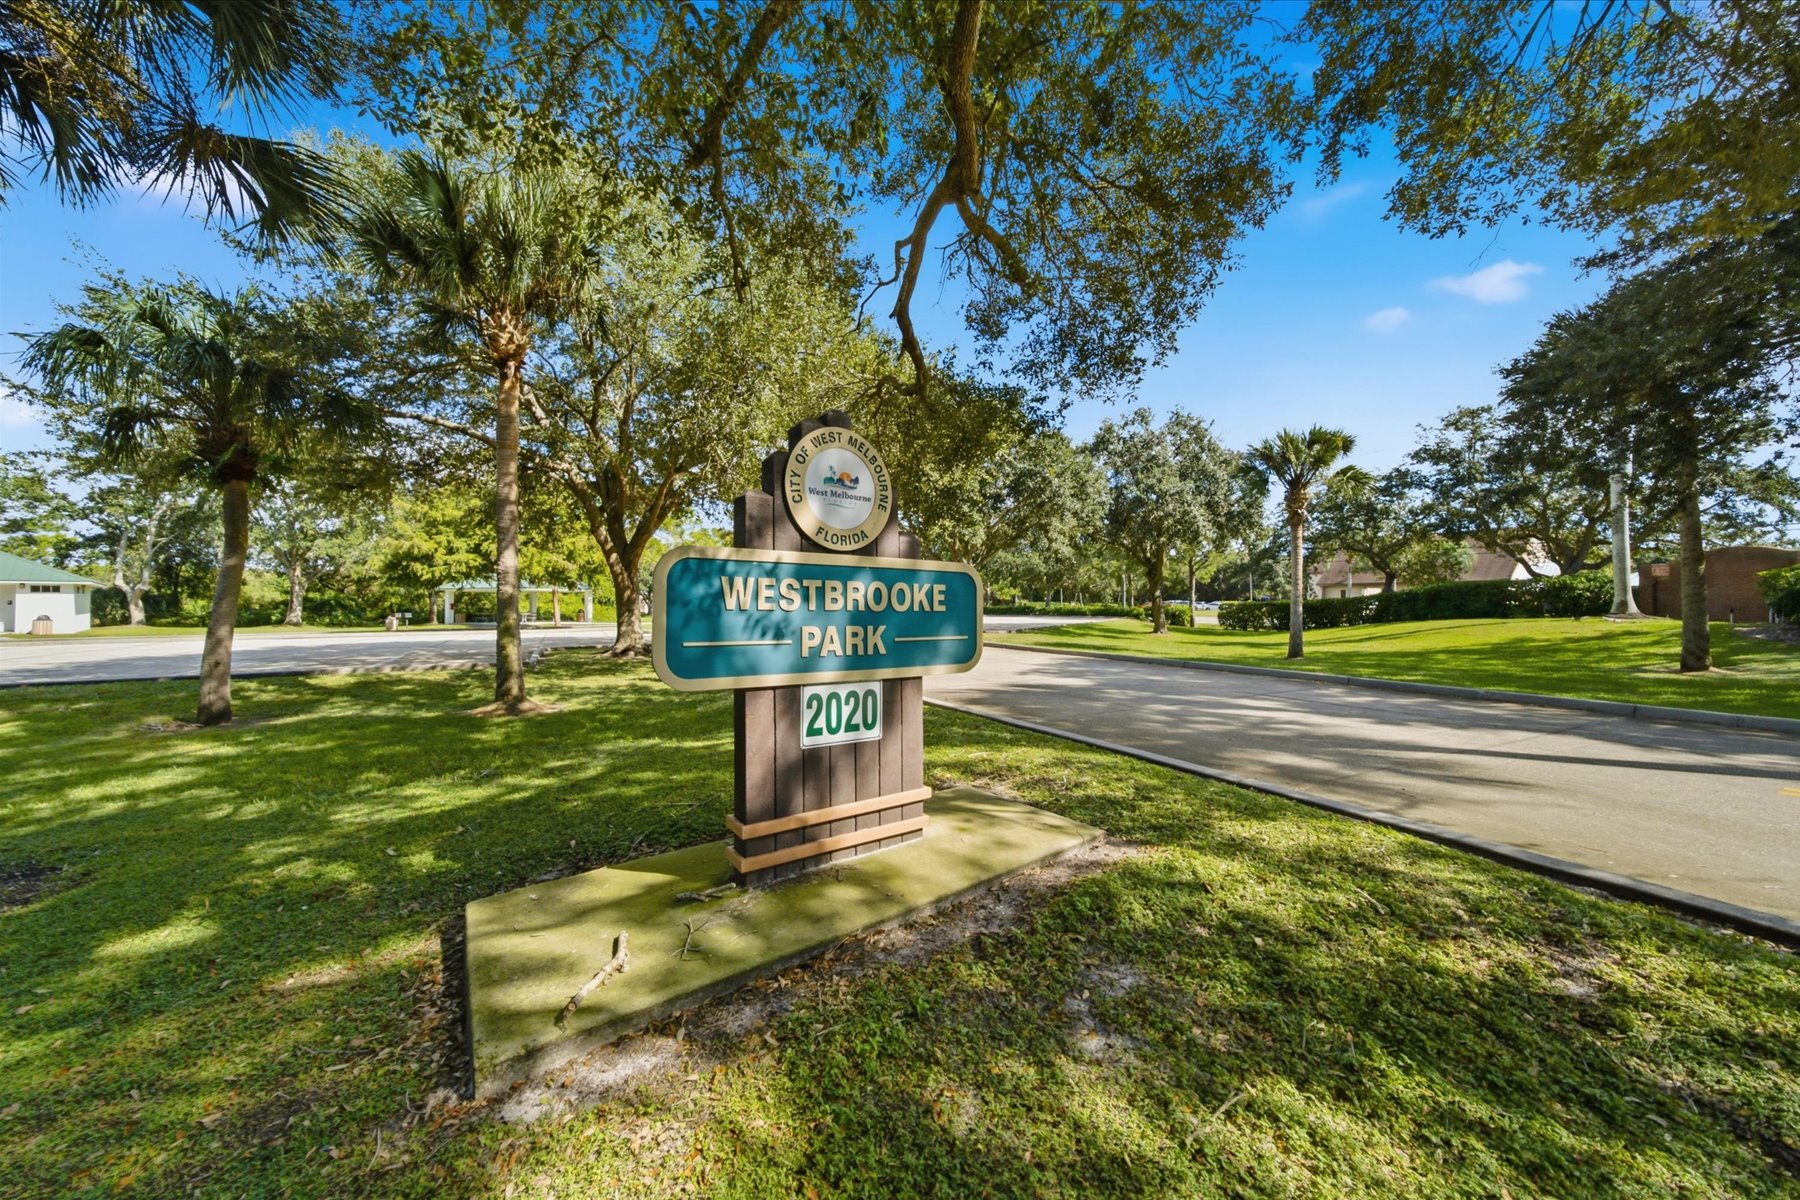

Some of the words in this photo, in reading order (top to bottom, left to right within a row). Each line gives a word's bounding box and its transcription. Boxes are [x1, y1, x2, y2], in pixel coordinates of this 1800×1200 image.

[795, 445, 809, 465] OF
[810, 431, 843, 449] WEST
[790, 469, 803, 504] CITY
[847, 435, 889, 513] MELBOURNE
[808, 487, 829, 498] West
[829, 490, 872, 503] Melbourne
[815, 527, 869, 546] FLORIDA
[720, 575, 947, 612] WESTBROOKE
[801, 625, 888, 658] PARK
[805, 688, 879, 738] 2020
